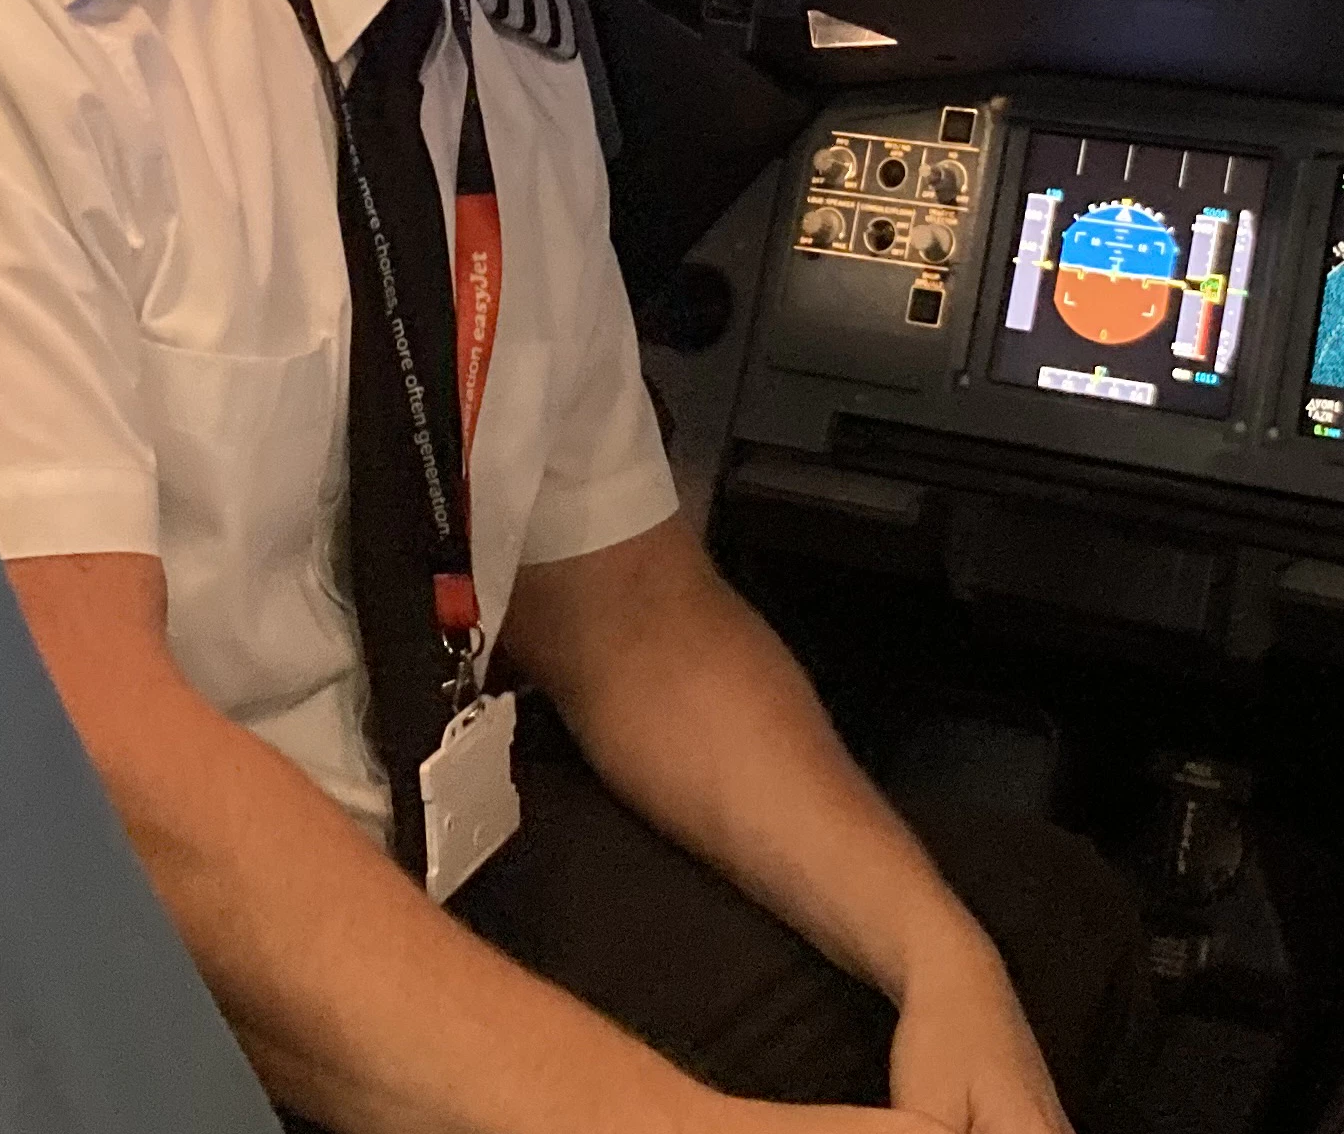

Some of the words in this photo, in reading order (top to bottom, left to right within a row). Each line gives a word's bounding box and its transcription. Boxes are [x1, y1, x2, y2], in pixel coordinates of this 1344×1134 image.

[358, 176, 380, 231] more
[374, 233, 399, 317] choices,
[391, 318, 415, 371] more
[405, 374, 426, 426] often
[468, 251, 489, 341] easyJet
